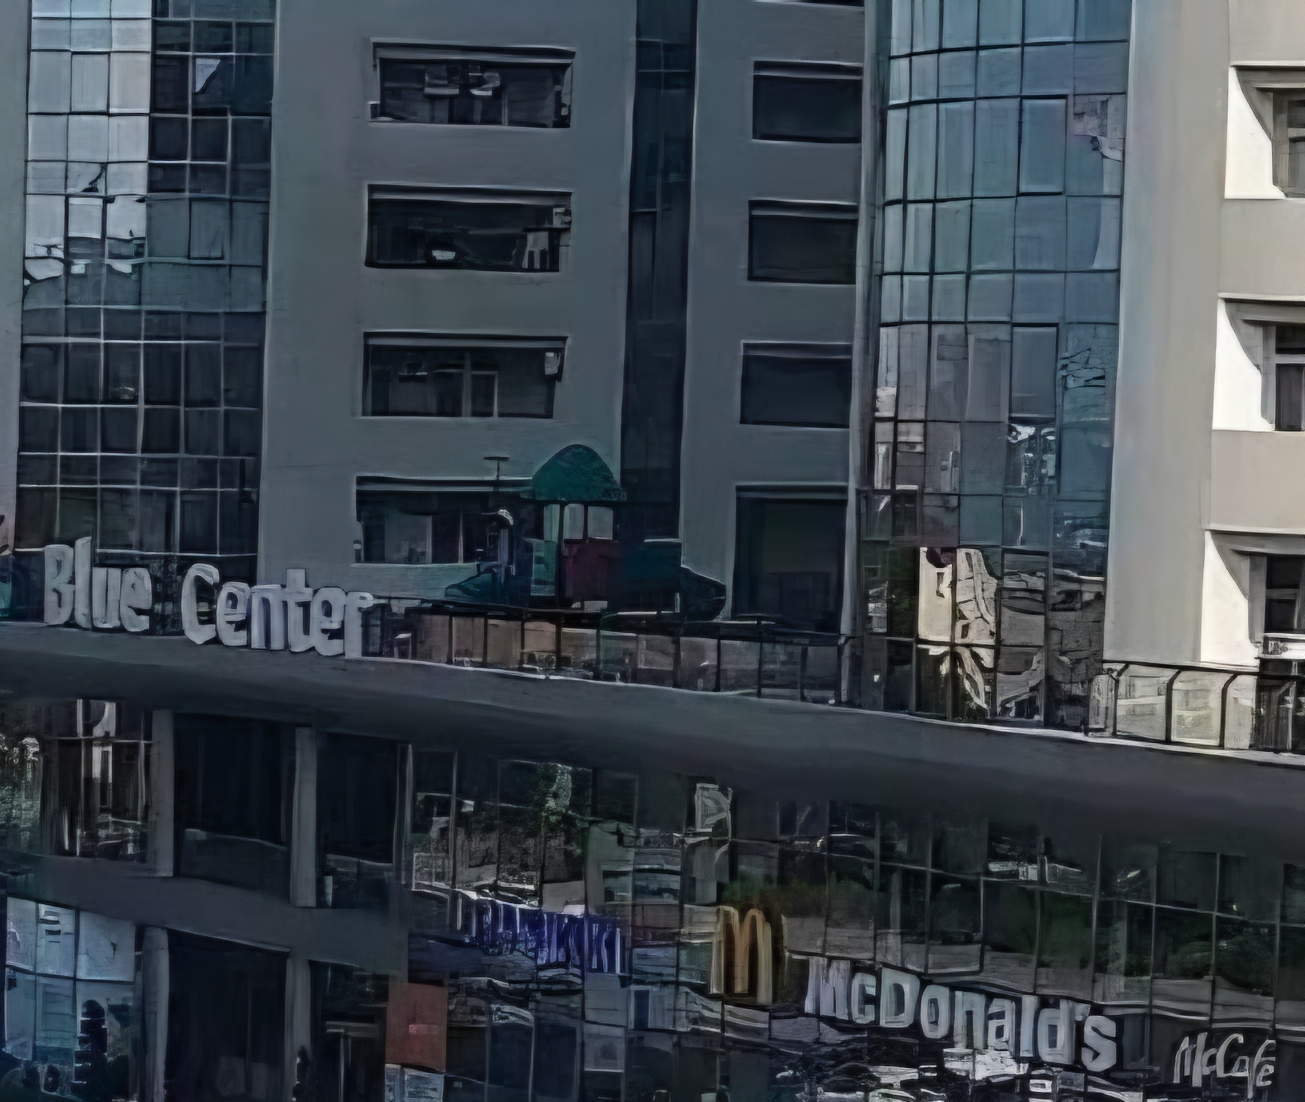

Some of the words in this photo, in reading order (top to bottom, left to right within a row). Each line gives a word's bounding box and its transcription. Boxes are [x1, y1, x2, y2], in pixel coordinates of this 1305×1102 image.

[44, 536, 153, 632] Blue
[182, 563, 375, 659] Center
[804, 957, 1117, 1072] McDonald's
